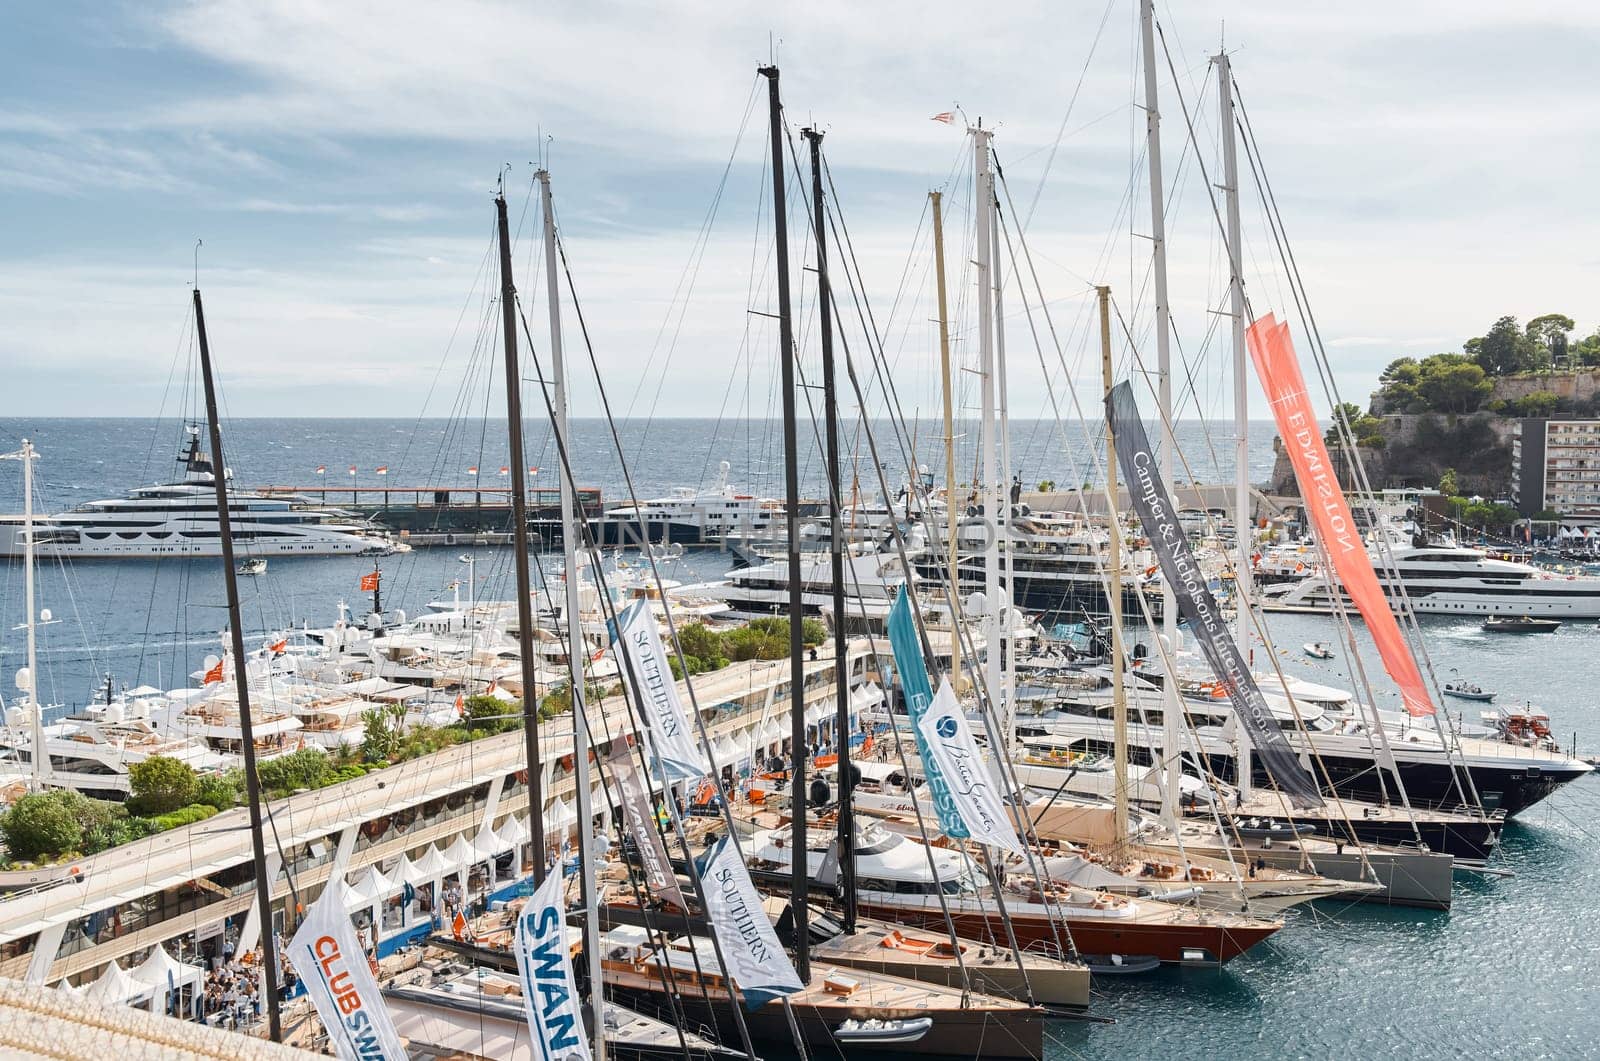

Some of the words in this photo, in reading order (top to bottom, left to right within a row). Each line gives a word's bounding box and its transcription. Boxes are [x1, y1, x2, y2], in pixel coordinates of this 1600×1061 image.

[1133, 451, 1166, 521] Camper
[1158, 523, 1175, 541] &
[1166, 538, 1218, 633] Nicholsons
[633, 630, 680, 738] SOUTHERN
[1212, 631, 1281, 744] International
[911, 692, 963, 832] BGESS
[715, 868, 773, 964] SOUTHERN
[527, 906, 579, 1051] SWAN
